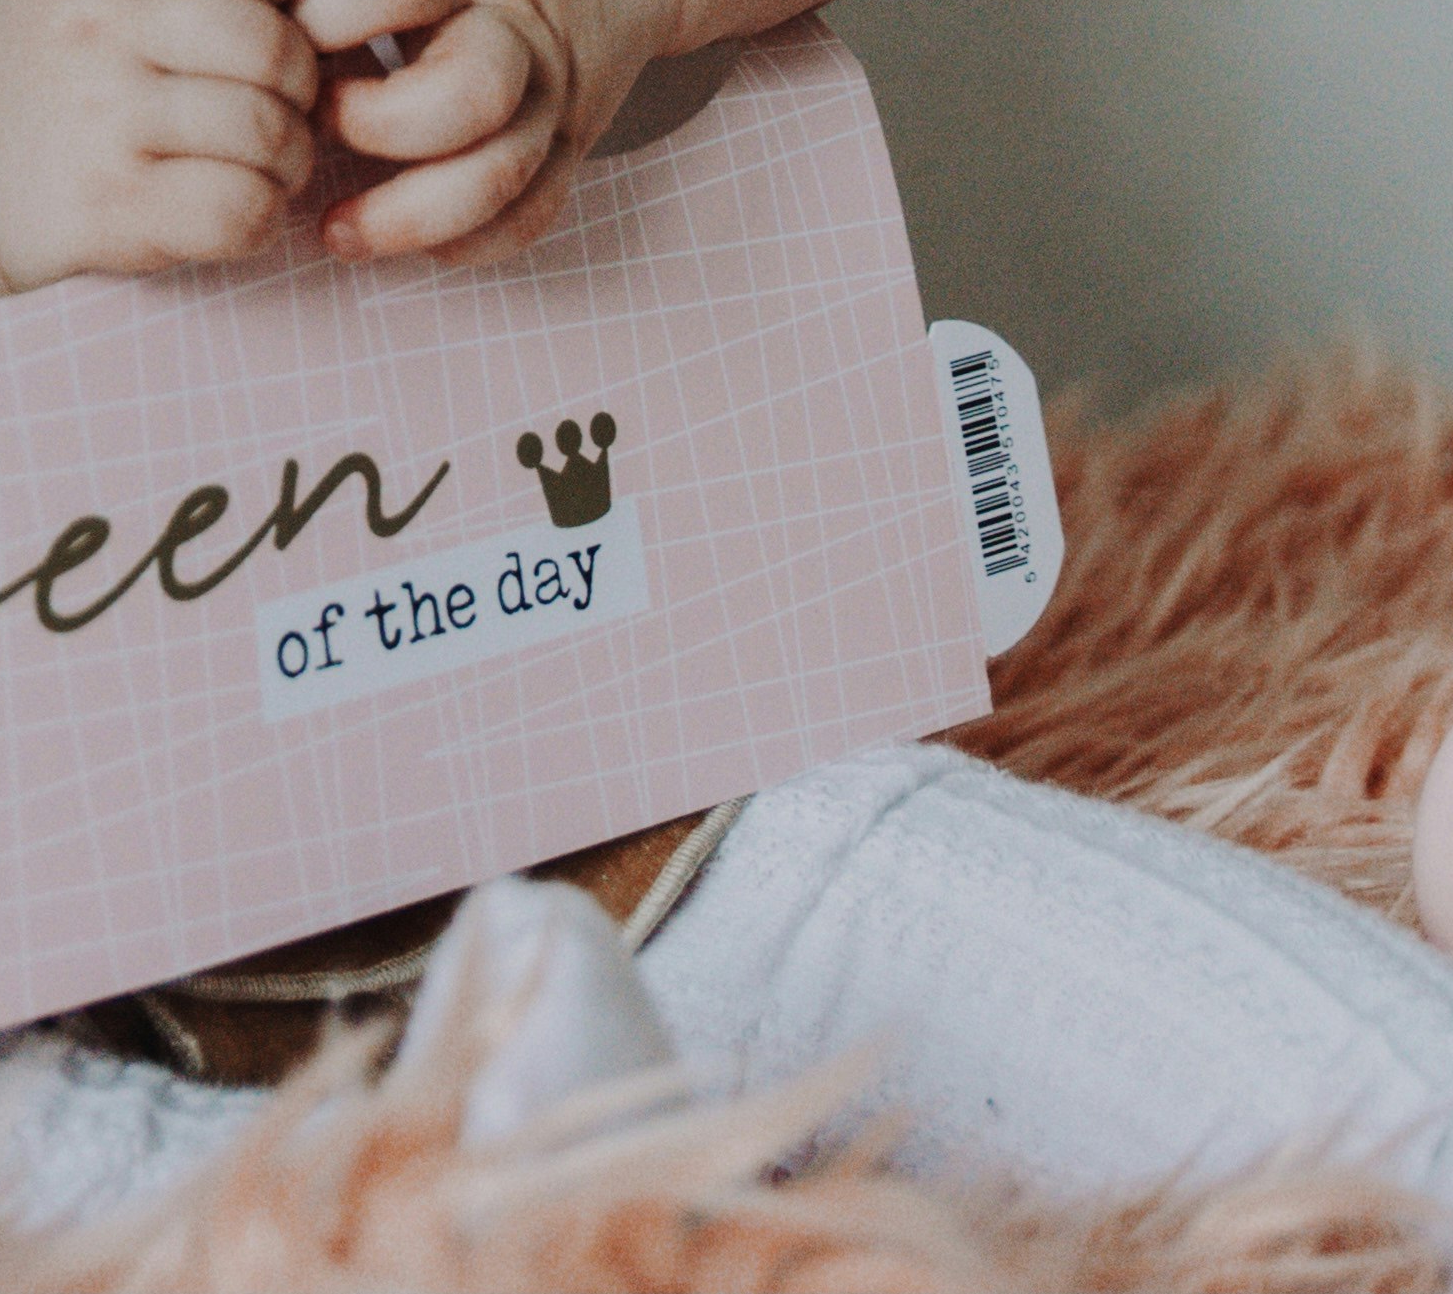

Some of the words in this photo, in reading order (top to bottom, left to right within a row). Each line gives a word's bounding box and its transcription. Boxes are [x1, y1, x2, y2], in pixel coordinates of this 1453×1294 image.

[988, 357, 1015, 449] 510475
[1007, 463, 1030, 554] 420043
[277, 602, 344, 679] of
[364, 581, 477, 651] the
[497, 543, 601, 615] day
